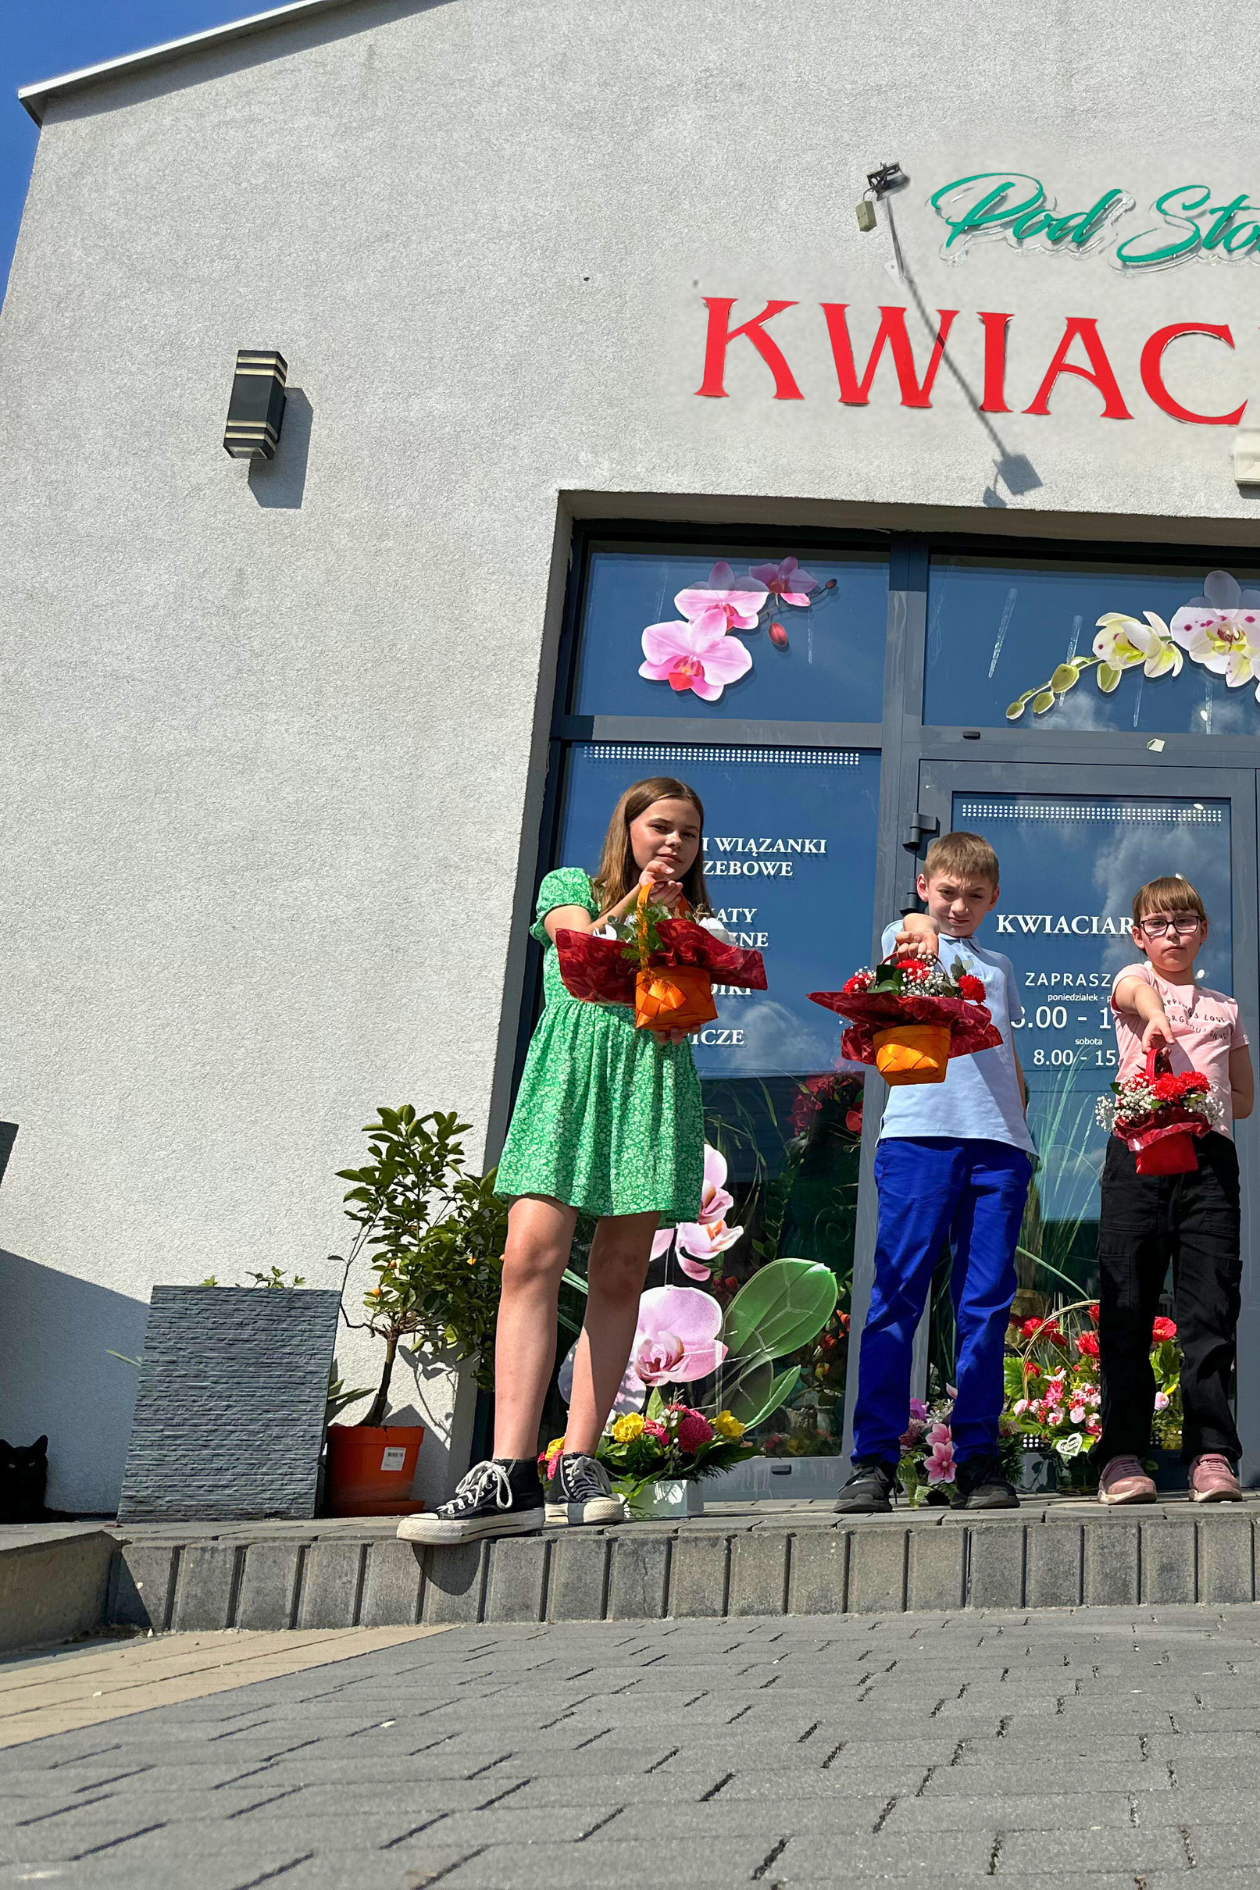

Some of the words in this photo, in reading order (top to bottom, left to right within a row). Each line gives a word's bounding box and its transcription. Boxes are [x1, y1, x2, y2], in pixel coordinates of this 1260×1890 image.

[931, 172, 1123, 249] Pod
[714, 837, 827, 857] WIĄZANKI
[712, 907, 757, 923] ATY
[996, 914, 1134, 935] KWIACIAR
[1025, 972, 1111, 987] ZAPRASZ
[1047, 993, 1099, 1003] poniedziałek
[688, 1029, 745, 1045] ICZE
[1075, 1037, 1103, 1046] sobota
[1033, 1049, 1074, 1066] 8.00
